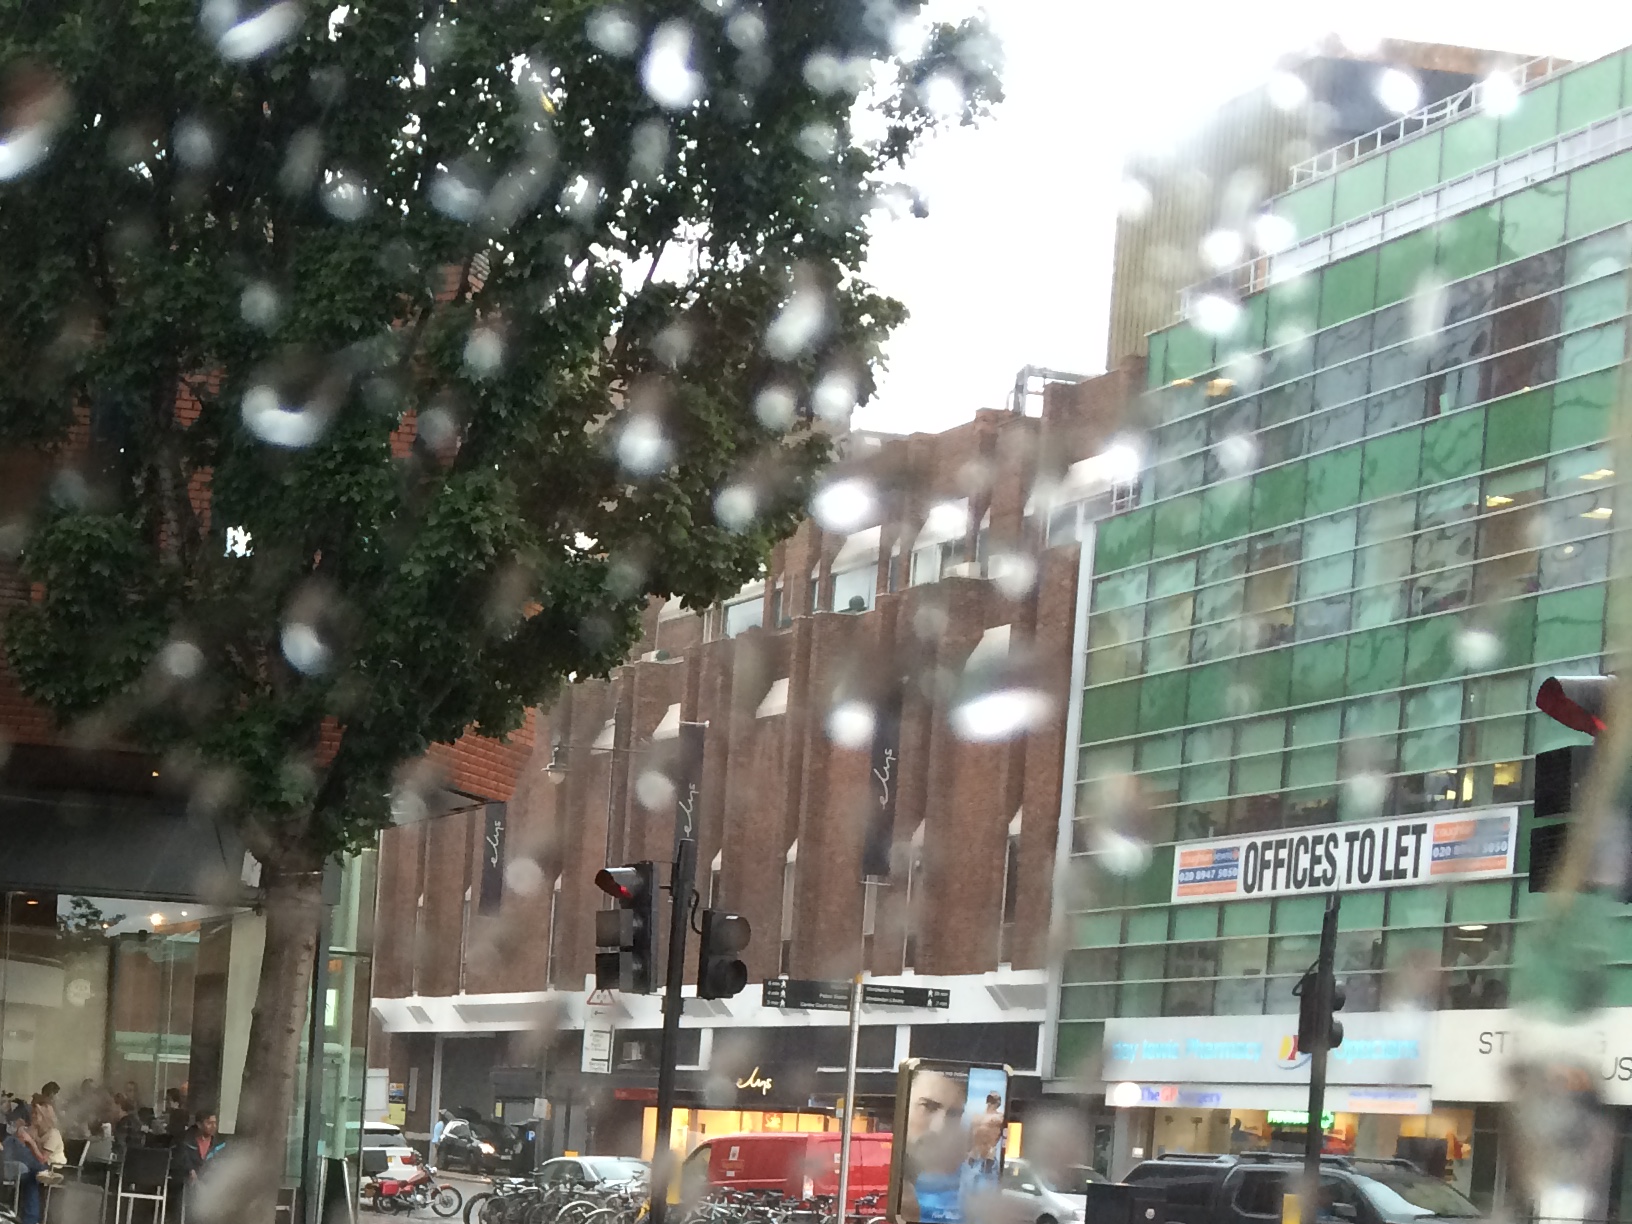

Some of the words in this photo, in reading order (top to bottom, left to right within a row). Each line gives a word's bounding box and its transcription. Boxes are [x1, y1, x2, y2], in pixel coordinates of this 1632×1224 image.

[1242, 832, 1339, 894] OFFICES
[1344, 828, 1376, 885] TO
[1379, 823, 1428, 882] LET
[736, 1066, 773, 1095] elys
